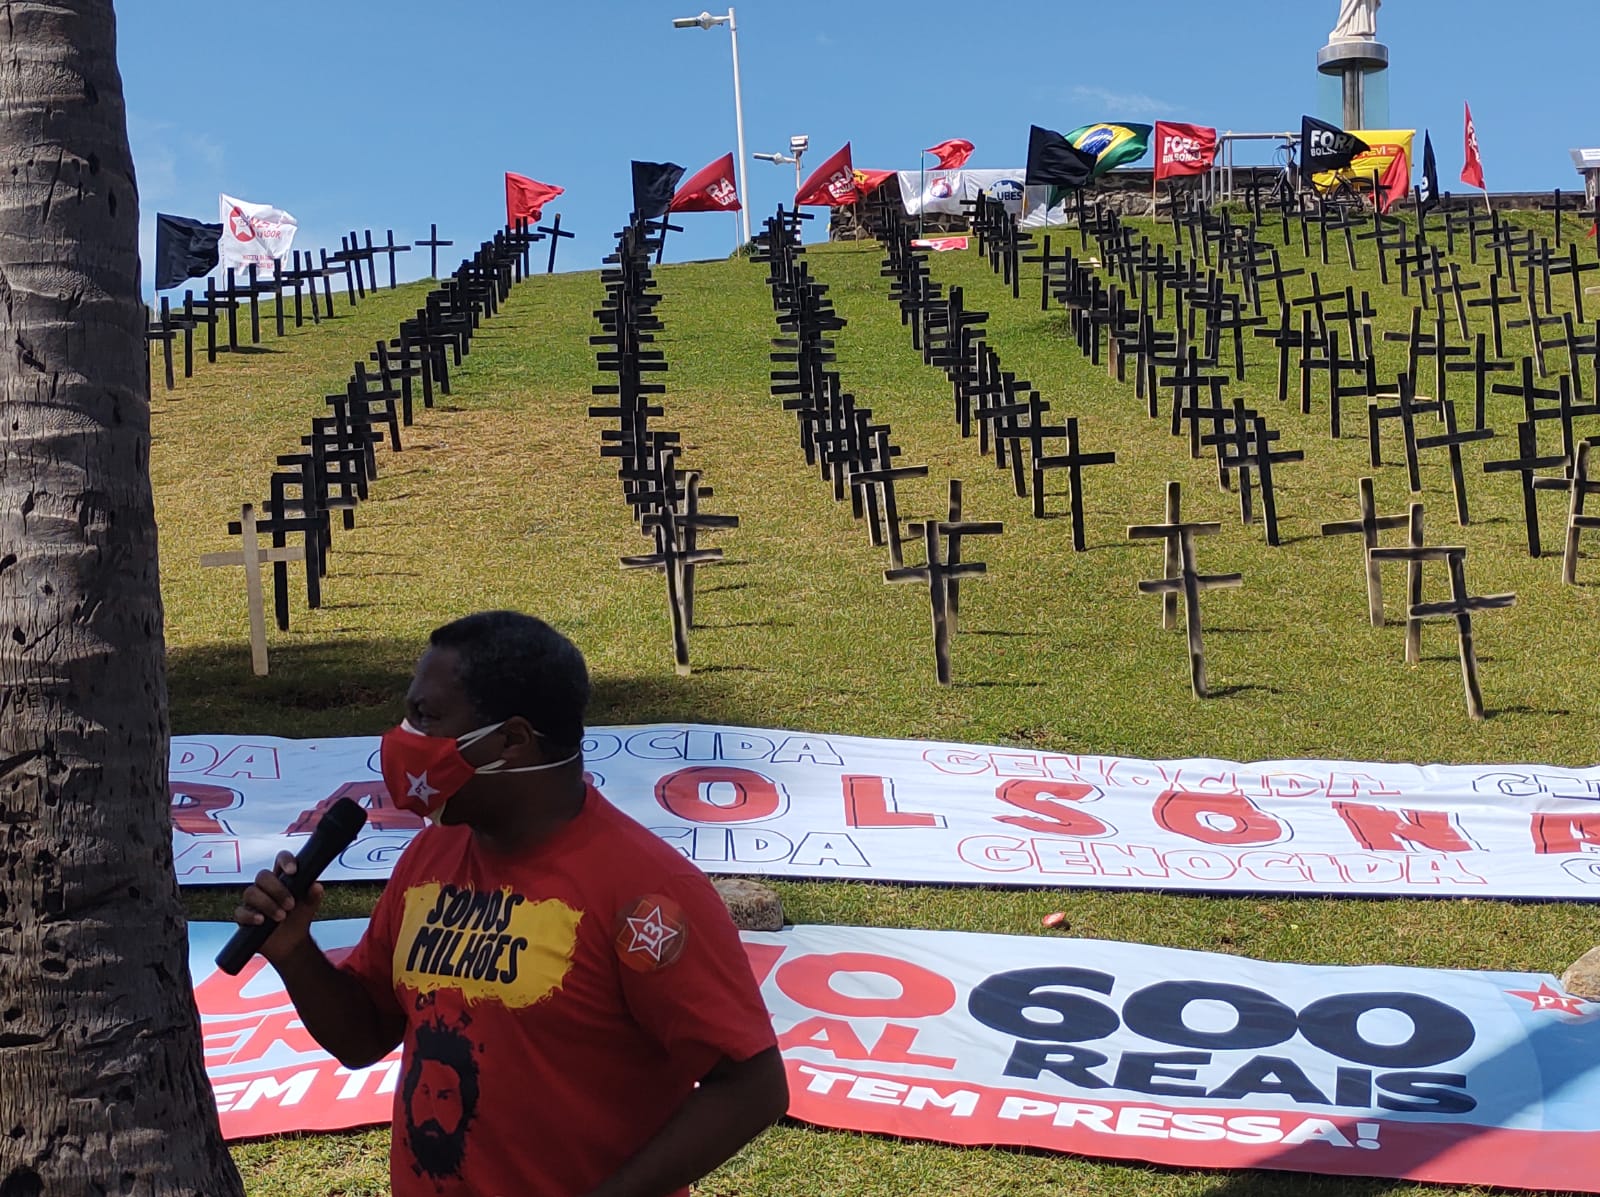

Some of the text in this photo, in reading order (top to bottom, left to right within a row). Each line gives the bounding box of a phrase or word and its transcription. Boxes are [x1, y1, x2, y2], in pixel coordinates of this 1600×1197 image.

[997, 191, 1023, 201] UBES
[957, 835, 1488, 885] GENOCIDA
[427, 884, 525, 932] SOMOS
[405, 926, 528, 984] MILHÕES
[637, 921, 664, 950] 13
[967, 965, 1477, 1070] 600
[1537, 995, 1571, 1009] PT
[1002, 1039, 1478, 1114] REAIS
[798, 1065, 980, 1118] TEM
[997, 1096, 1382, 1151] PRESSA!
